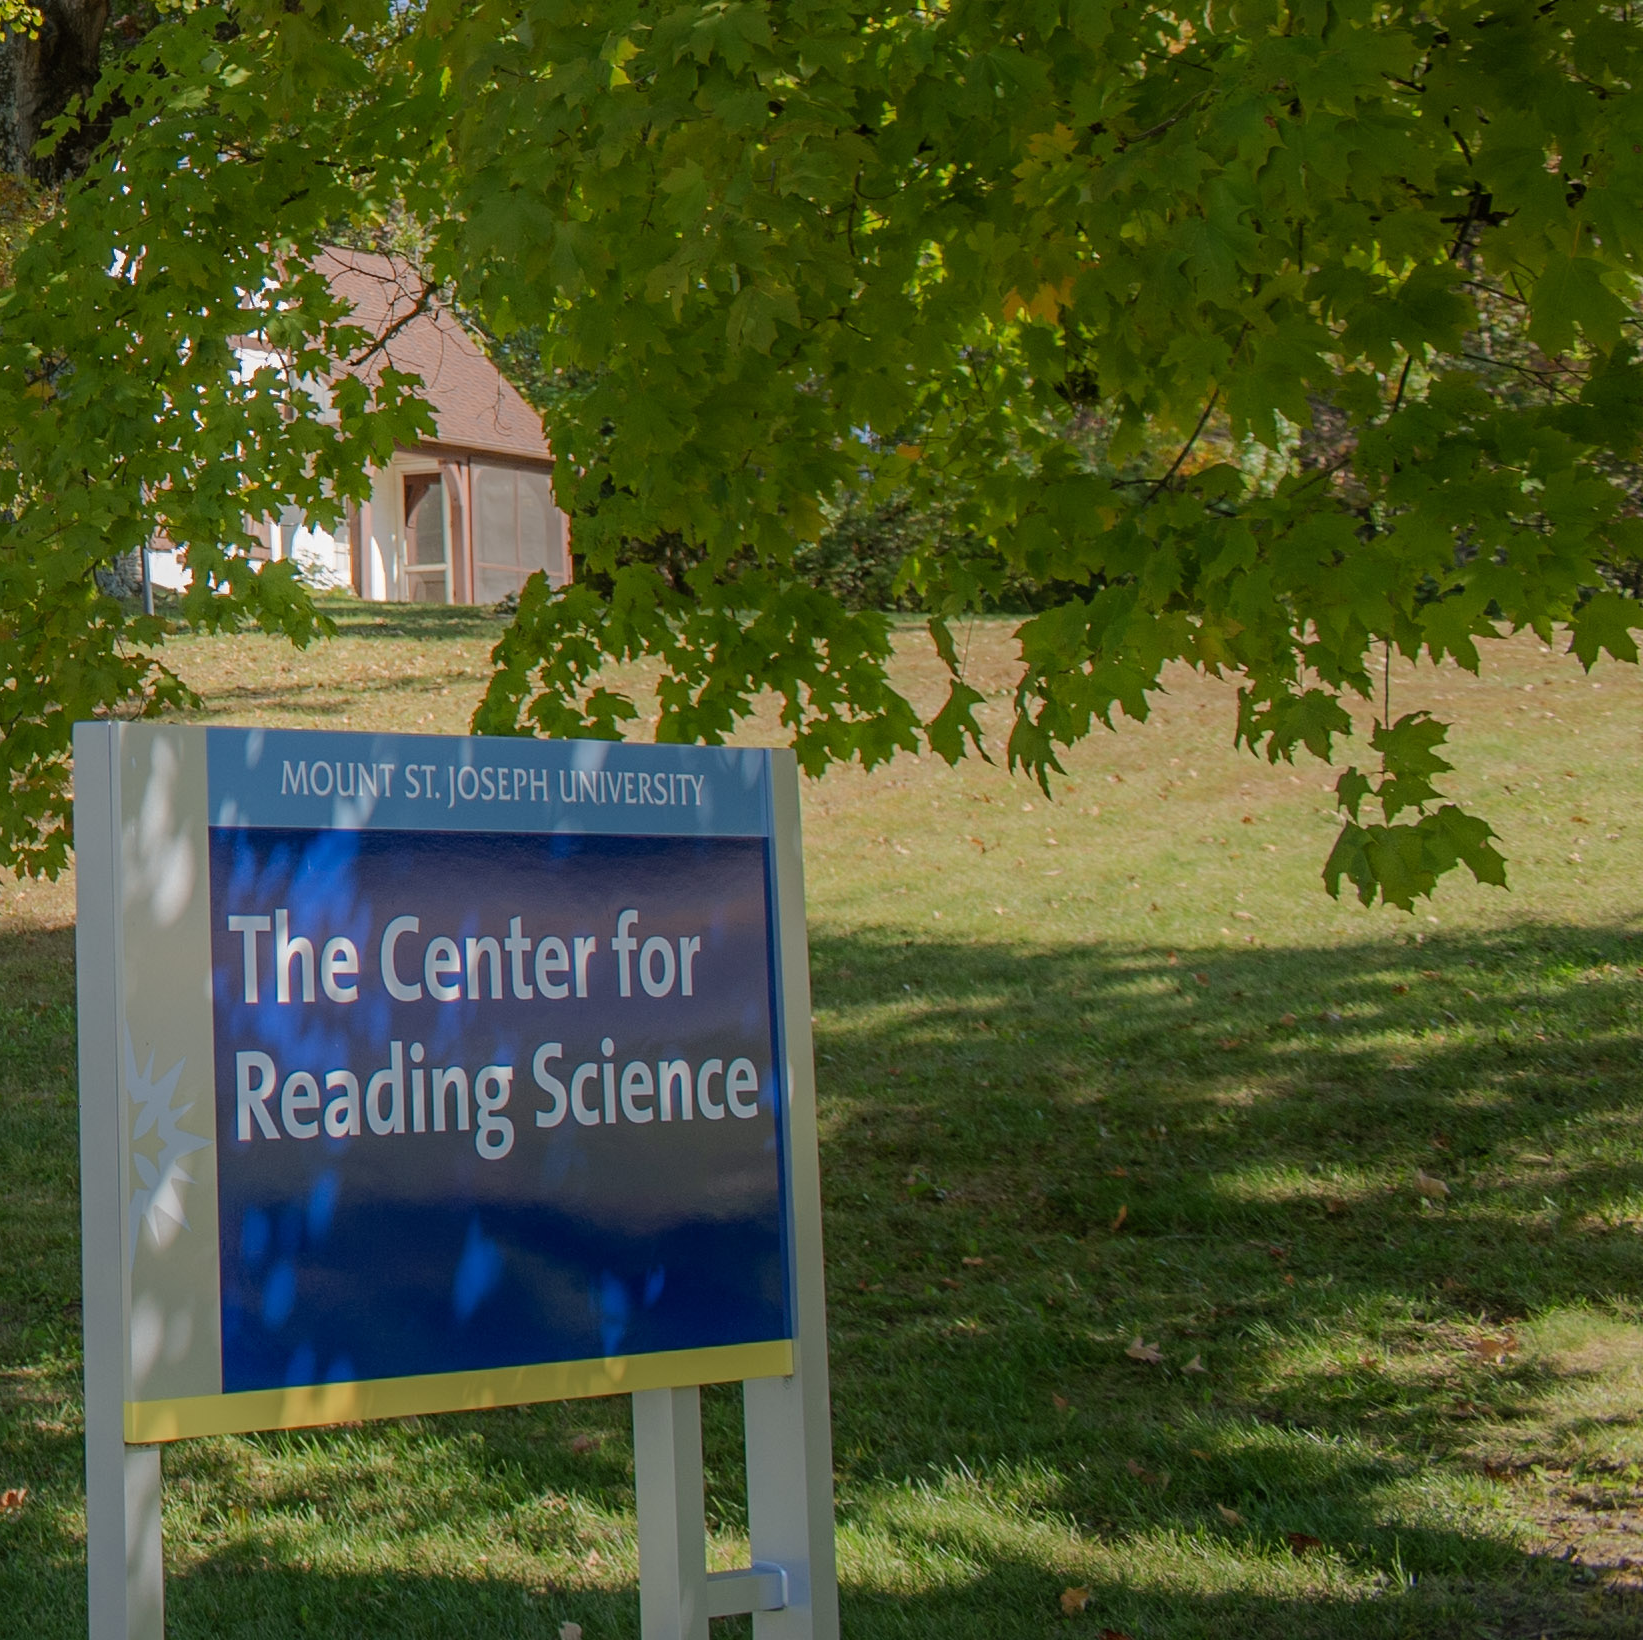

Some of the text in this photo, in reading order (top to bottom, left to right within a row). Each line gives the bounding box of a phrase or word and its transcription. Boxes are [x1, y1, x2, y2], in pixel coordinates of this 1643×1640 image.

[280, 759, 706, 809] MOUNT ST. JOSEPH UNIVERSITY
[228, 908, 701, 1005] The Center for
[236, 1037, 760, 1161] Reading Science
